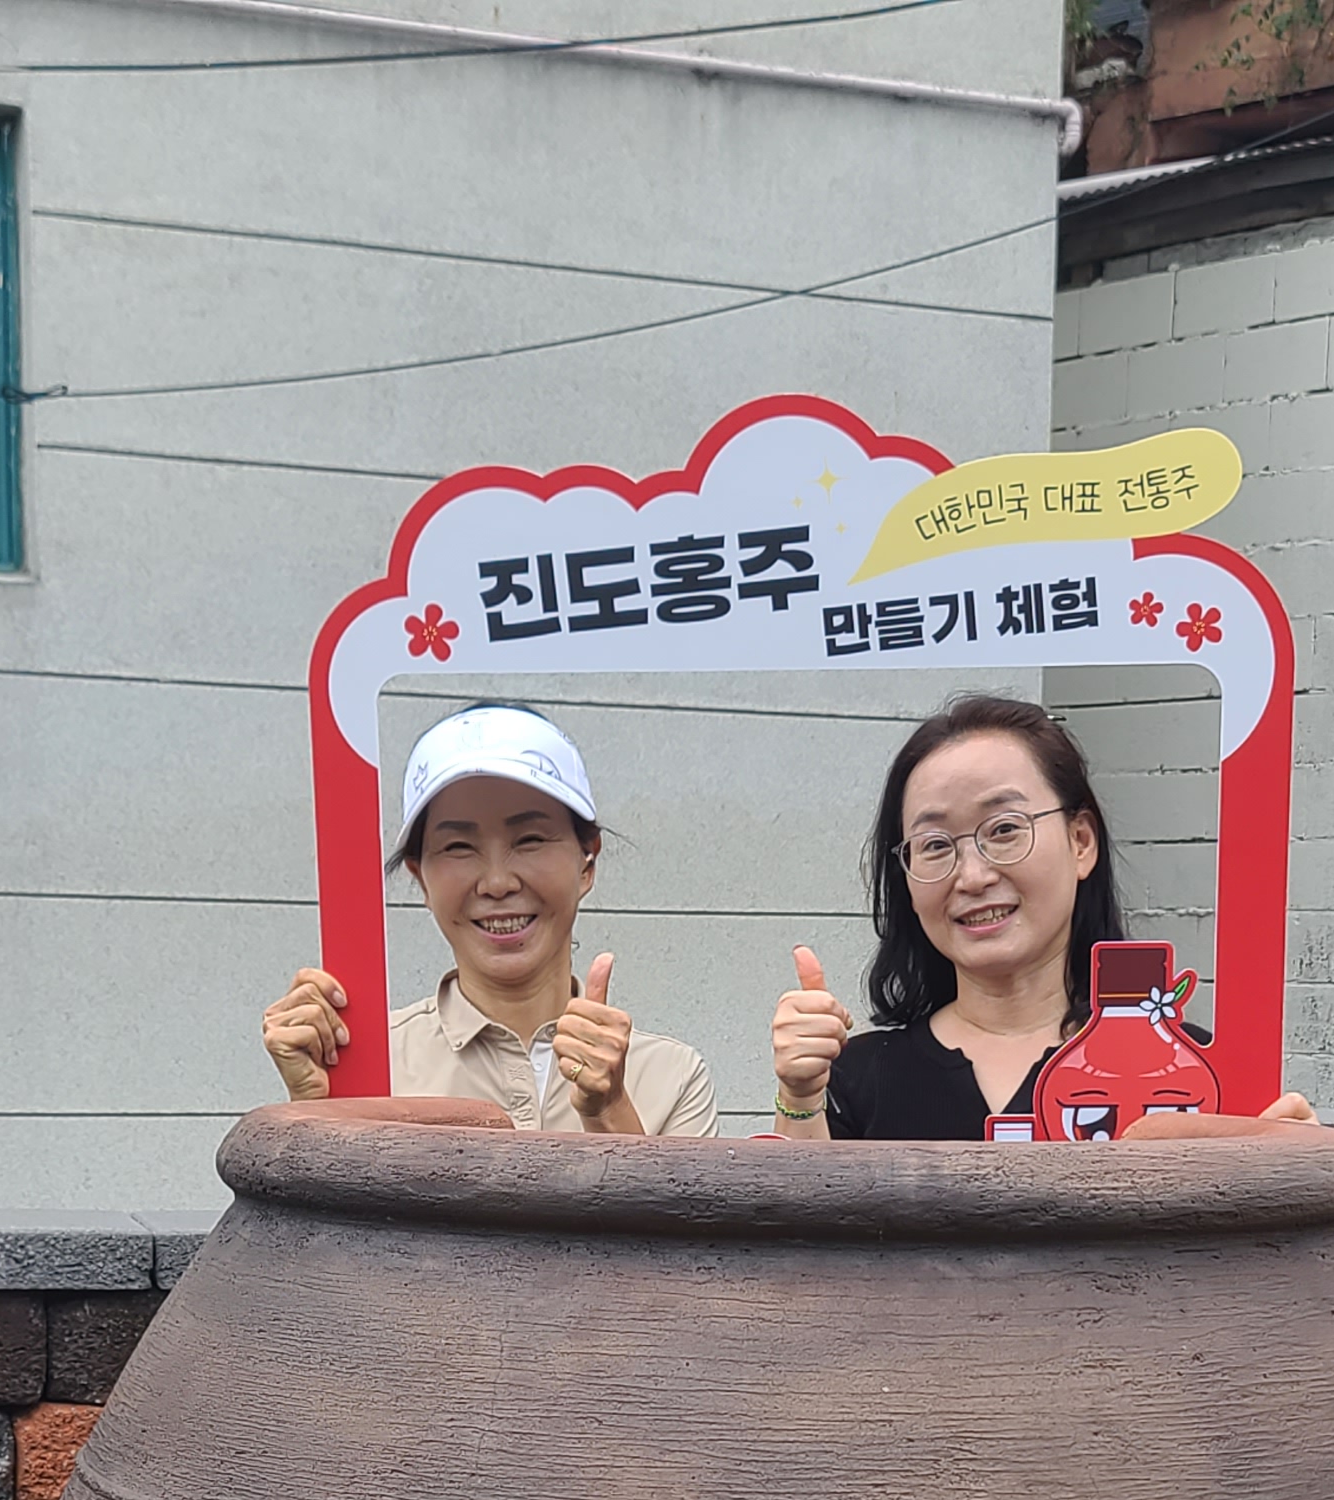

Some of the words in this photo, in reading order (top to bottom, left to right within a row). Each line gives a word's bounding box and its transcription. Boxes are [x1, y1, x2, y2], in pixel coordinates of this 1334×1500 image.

[914, 482, 1030, 541] 대한민국
[1043, 481, 1103, 514] 대표
[1116, 464, 1200, 513] 전통주
[478, 524, 820, 643] 진도홍주
[822, 590, 978, 657] 만들기
[996, 576, 1099, 636] 체험
